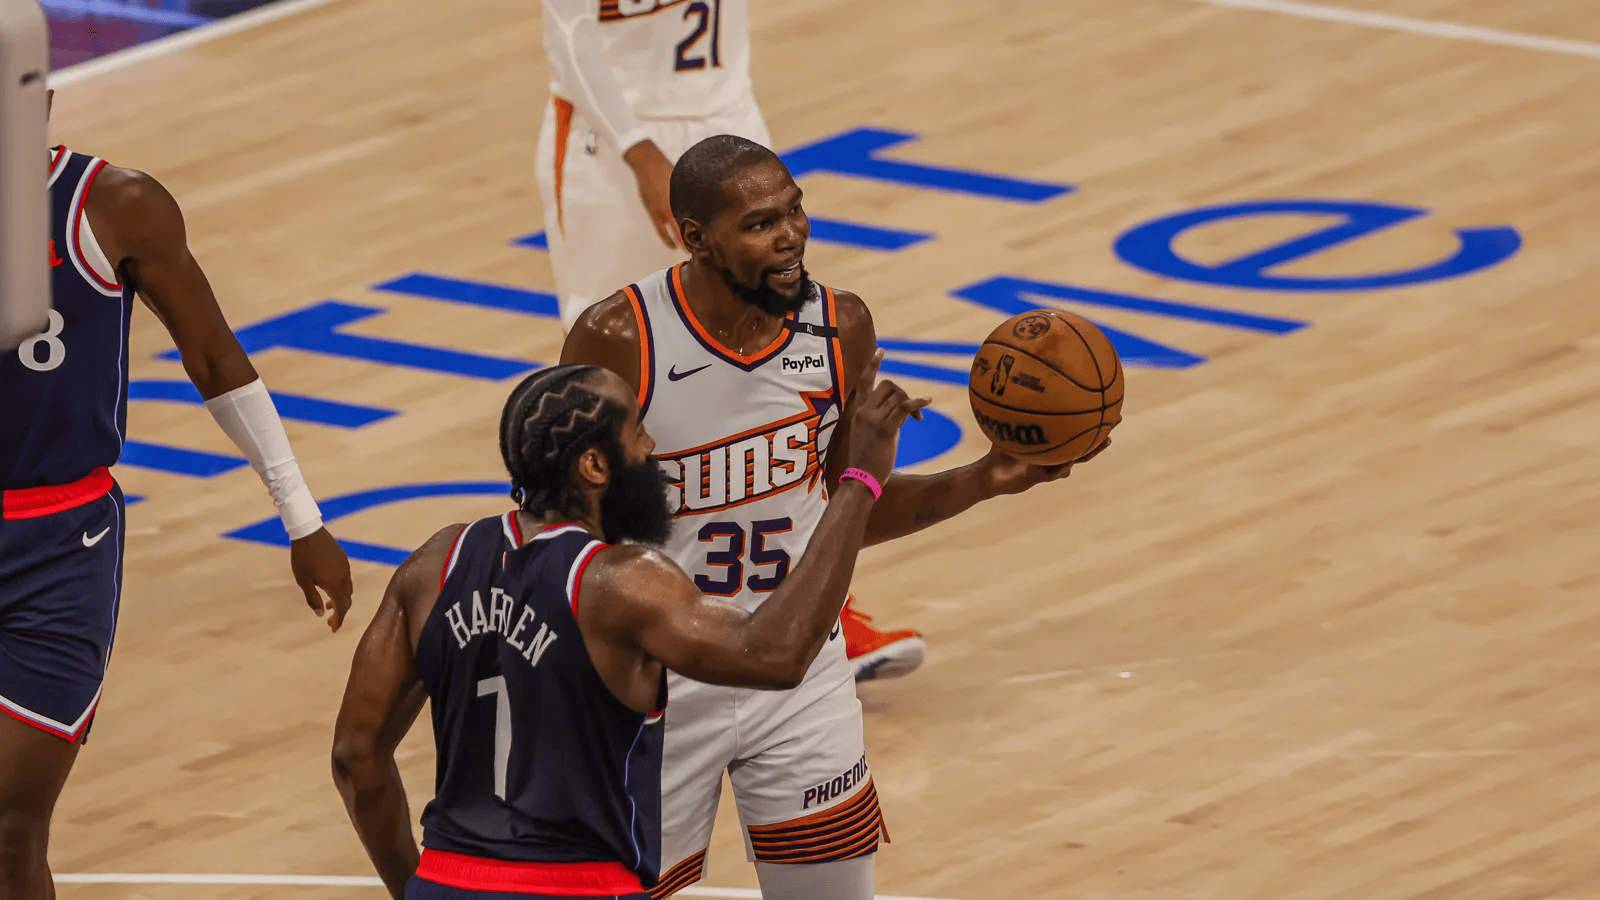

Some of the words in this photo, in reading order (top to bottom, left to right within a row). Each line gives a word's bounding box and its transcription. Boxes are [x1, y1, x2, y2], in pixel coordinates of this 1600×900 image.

[674, 0, 721, 72] 21
[18, 308, 65, 371] 8
[782, 354, 824, 373] PayPal
[694, 517, 792, 597] 35
[477, 675, 512, 801] 7
